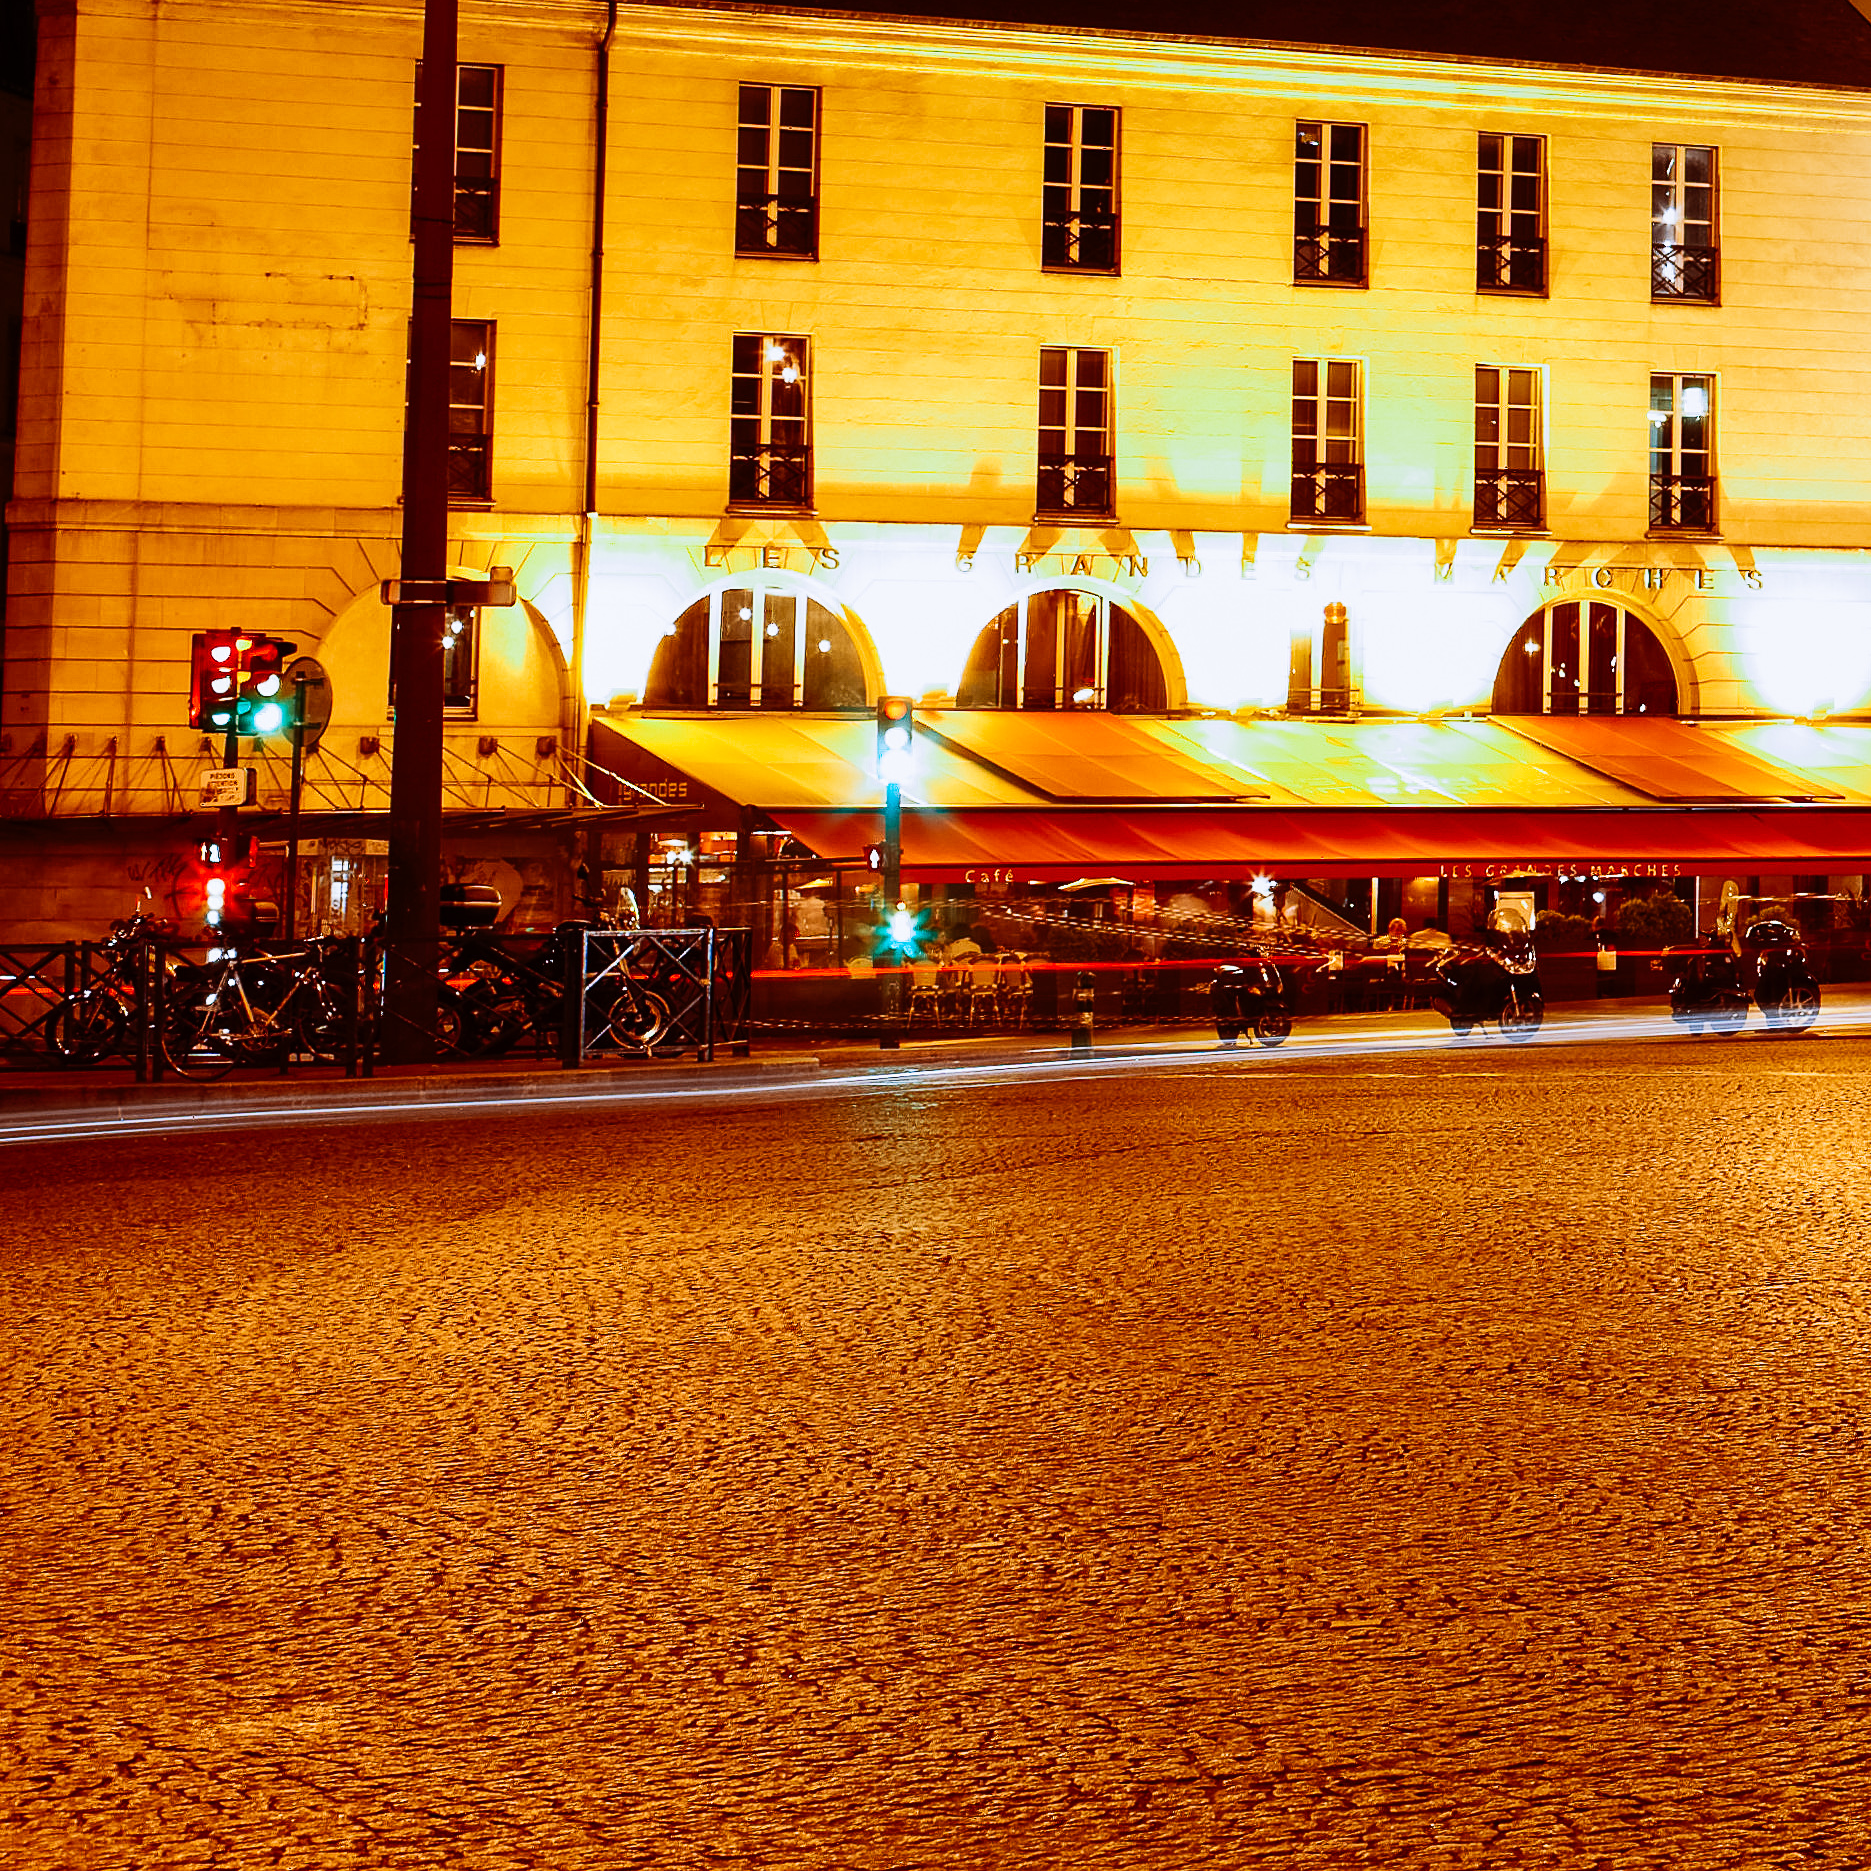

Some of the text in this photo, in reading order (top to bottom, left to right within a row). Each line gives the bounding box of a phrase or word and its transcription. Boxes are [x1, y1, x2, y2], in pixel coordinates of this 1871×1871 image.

[704, 545, 840, 570] LES
[954, 551, 1312, 580] GRANDES
[964, 868, 1014, 883] Café
[1440, 864, 1473, 878] LES
[1589, 864, 1682, 877] MARCHES
